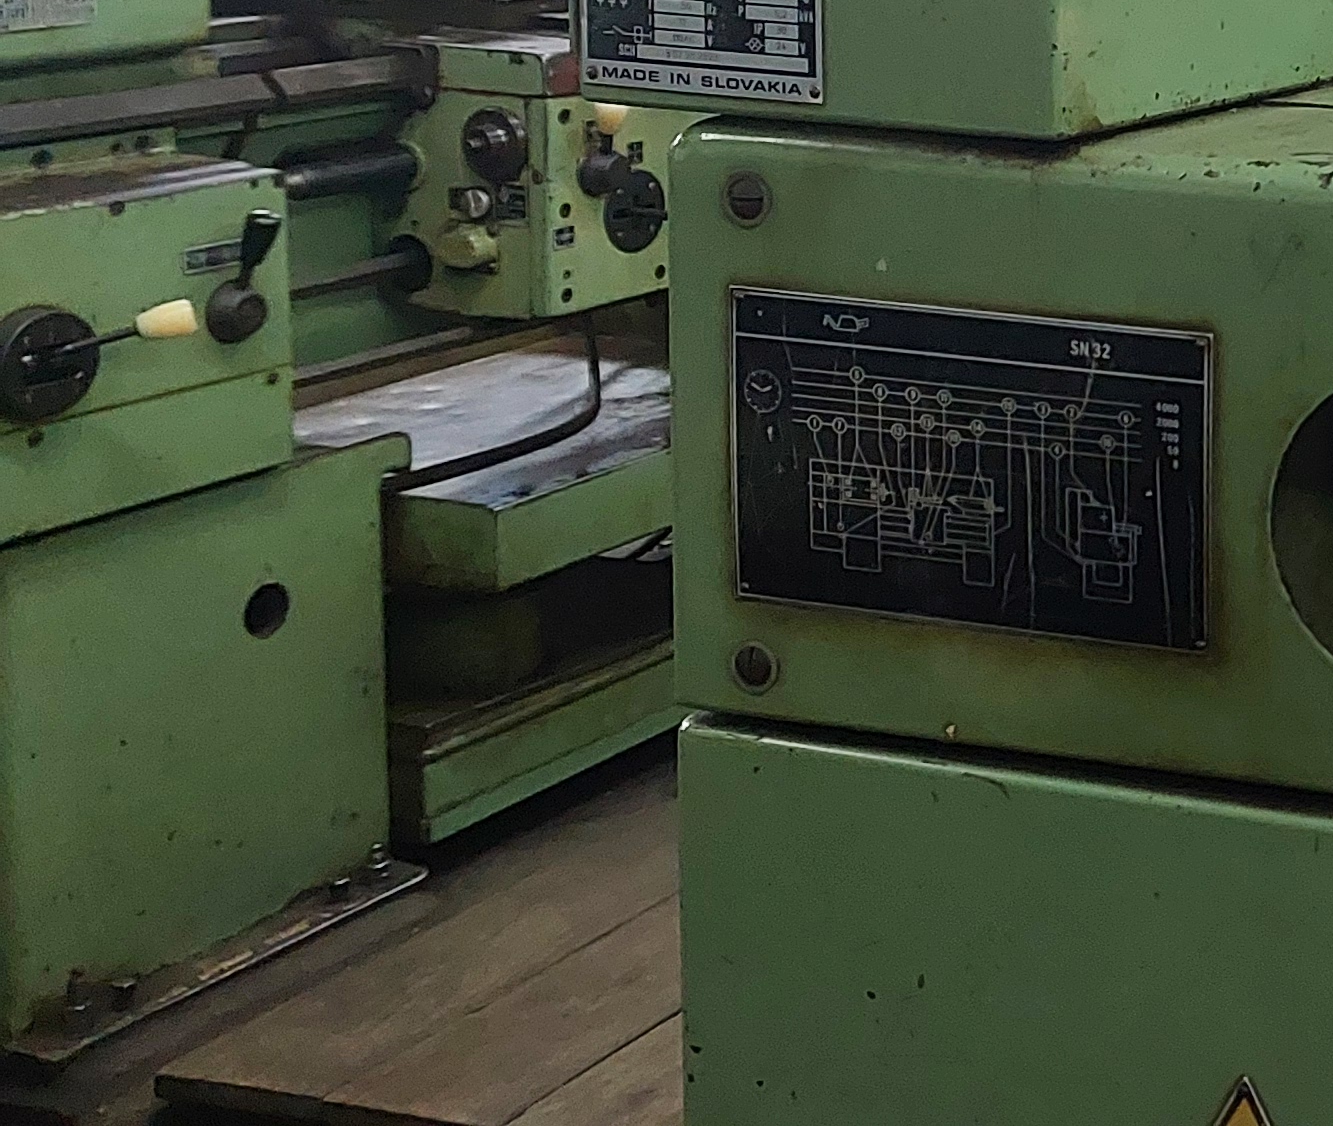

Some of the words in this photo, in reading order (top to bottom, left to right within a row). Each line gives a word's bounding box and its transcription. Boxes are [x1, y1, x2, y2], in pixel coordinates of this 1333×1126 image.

[601, 65, 660, 82] MADE
[670, 72, 691, 85] IN
[701, 75, 802, 96] SLOVAKIA
[1069, 339, 1090, 357] SN
[1092, 342, 1112, 360] 32
